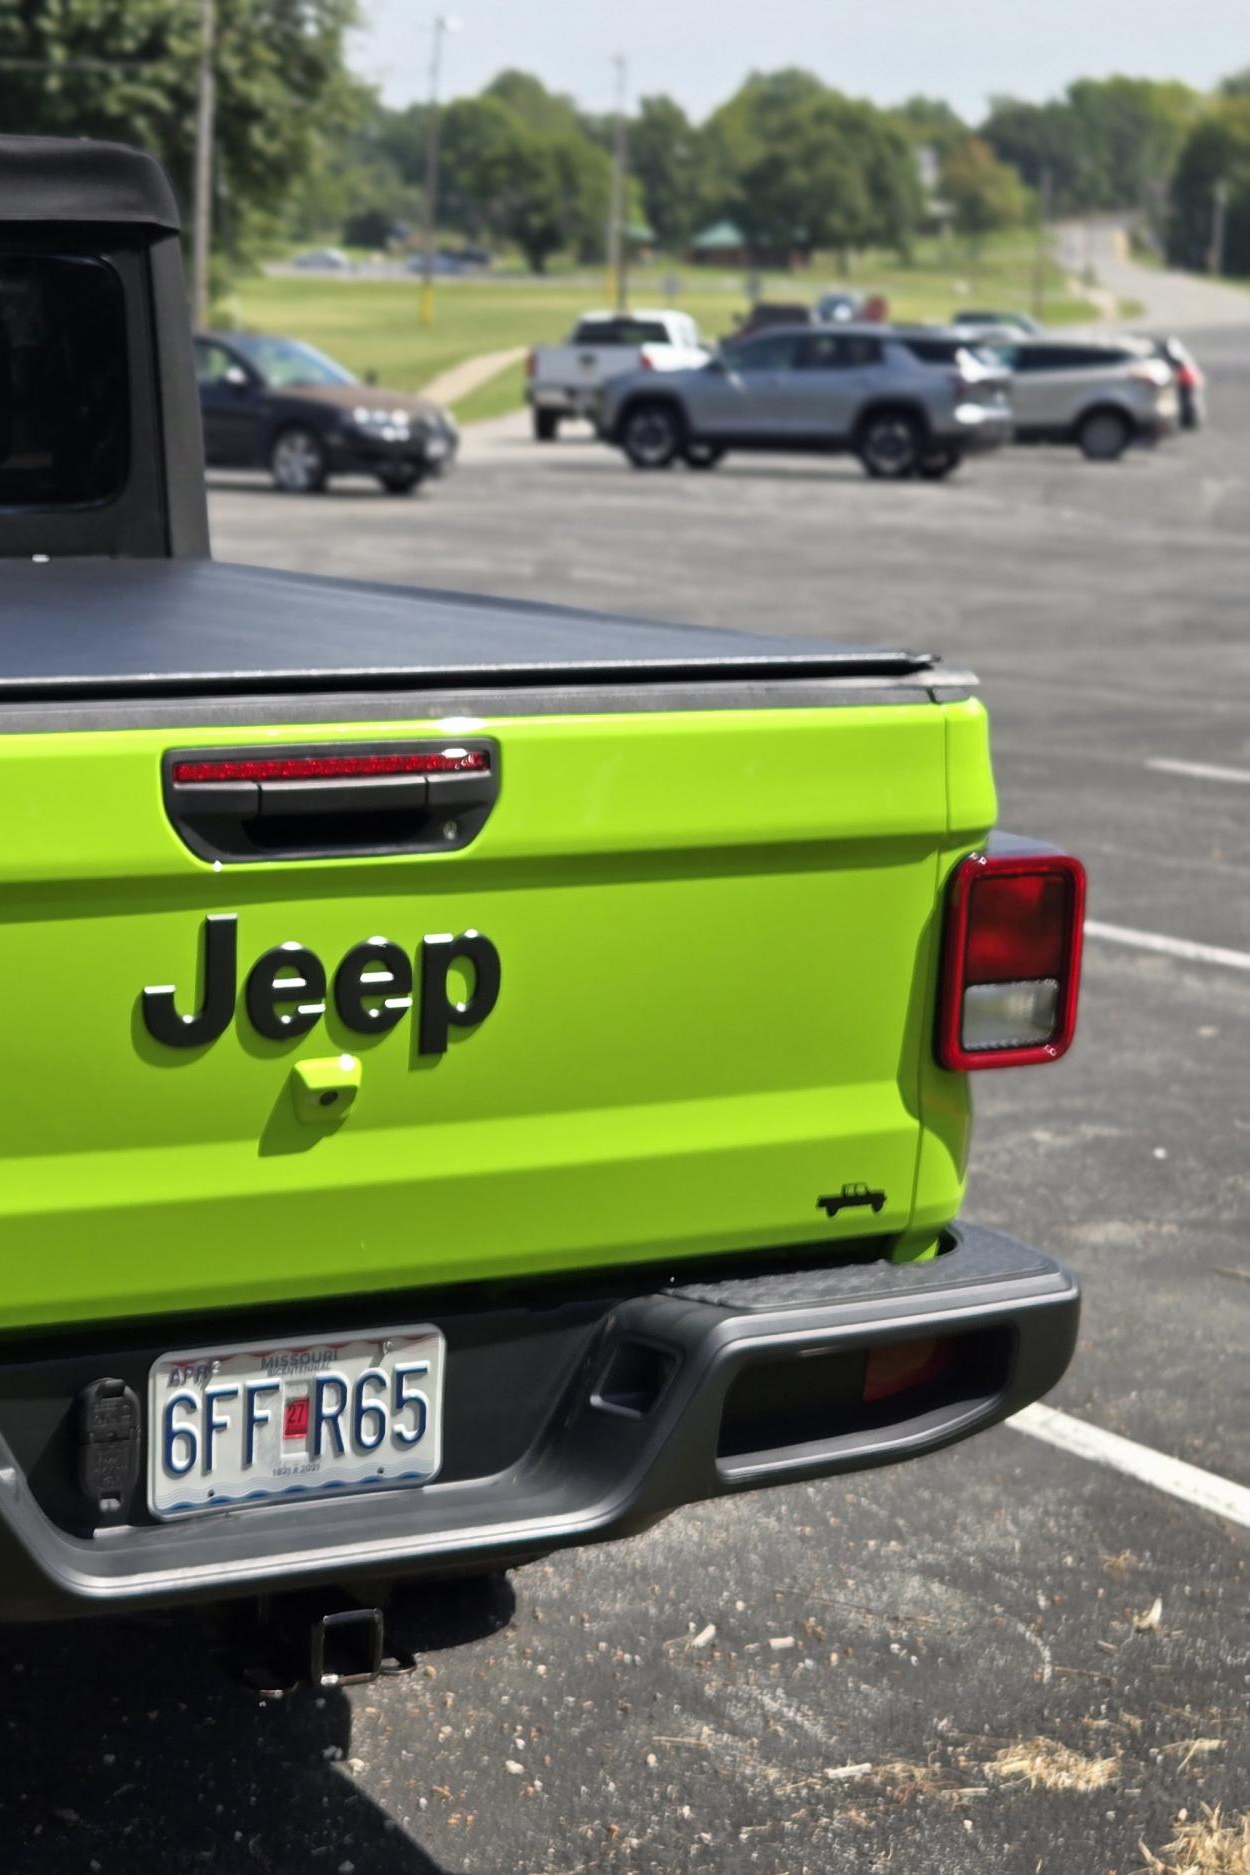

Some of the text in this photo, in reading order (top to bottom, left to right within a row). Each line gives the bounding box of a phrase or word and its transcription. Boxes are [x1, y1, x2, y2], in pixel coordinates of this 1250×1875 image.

[142, 913, 502, 1055] Jeep
[261, 1350, 338, 1370] MISSOURI
[164, 1361, 430, 1477] 6FF R65
[287, 1402, 304, 1423] 27
